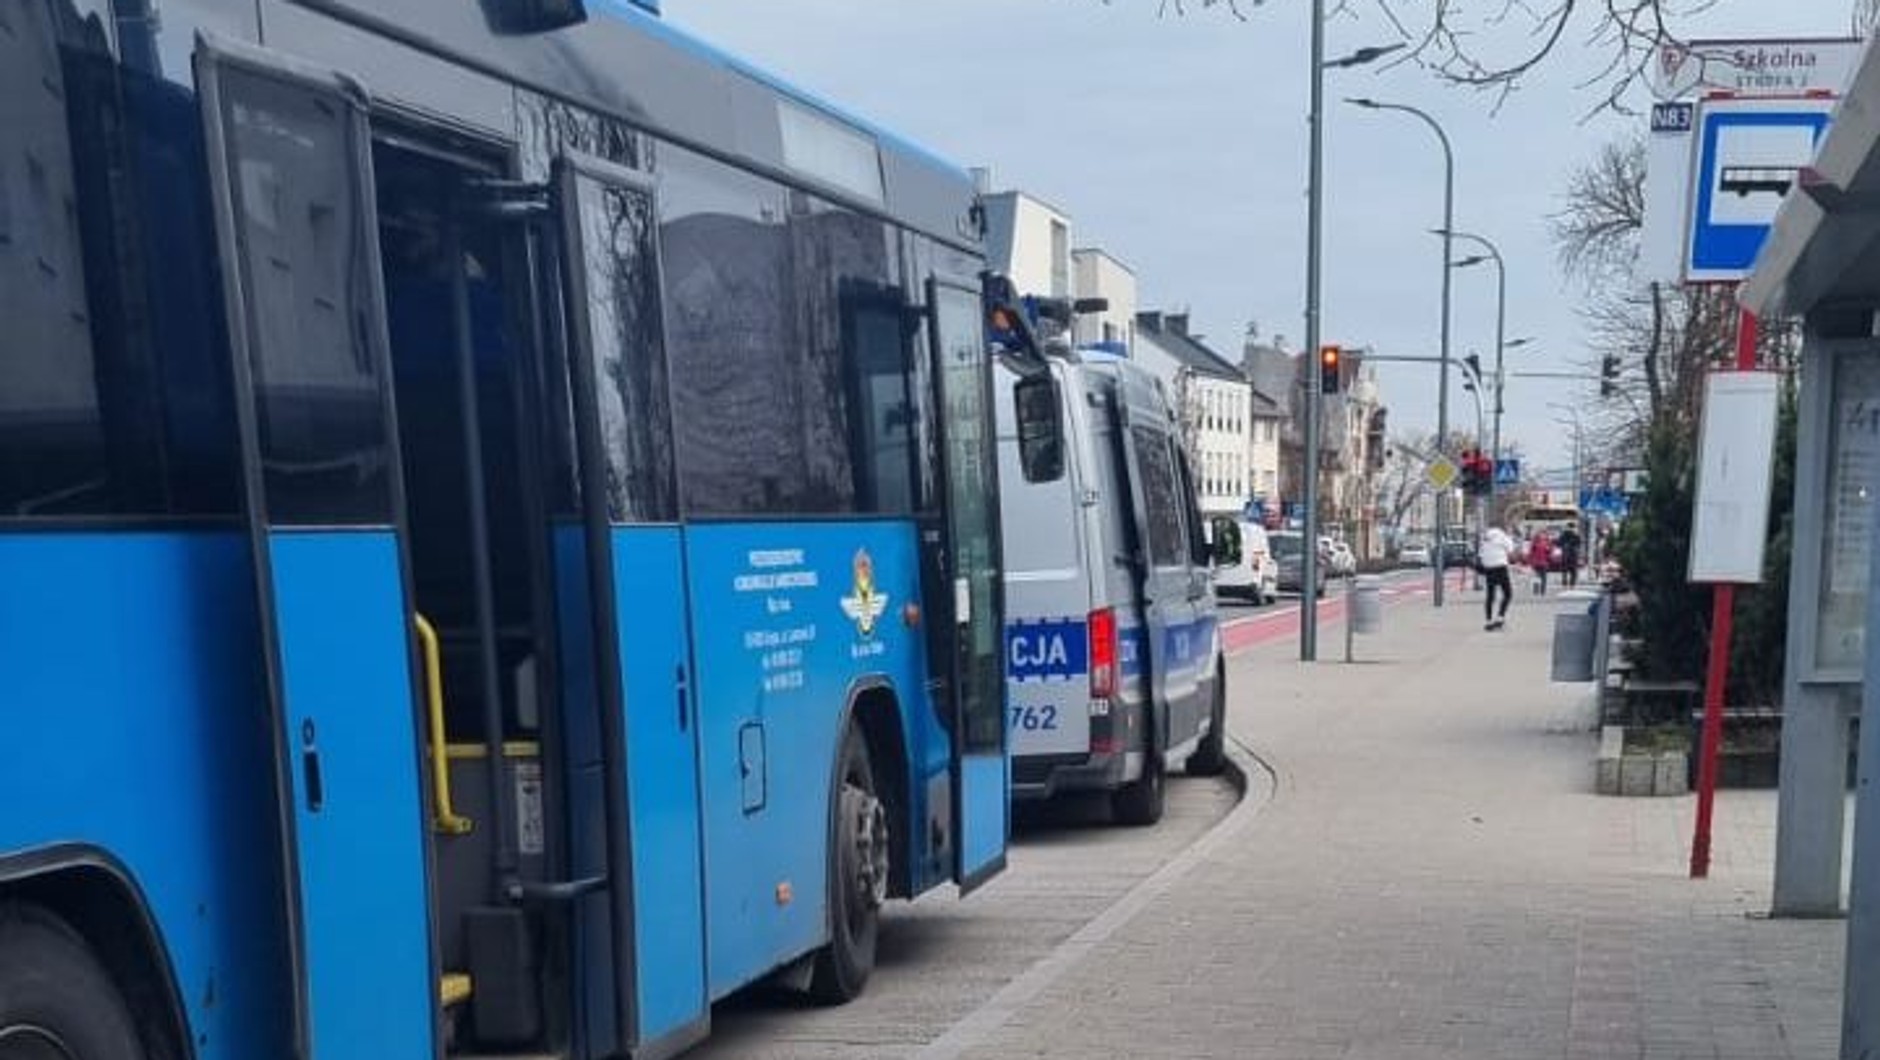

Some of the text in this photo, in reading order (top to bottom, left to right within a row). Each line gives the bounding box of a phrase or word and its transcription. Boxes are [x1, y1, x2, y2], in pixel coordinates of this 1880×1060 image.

[1733, 46, 1817, 70] Szkolna
[1652, 107, 1690, 128] N83
[1011, 634, 1067, 666] CJA
[1011, 704, 1057, 730] 762
